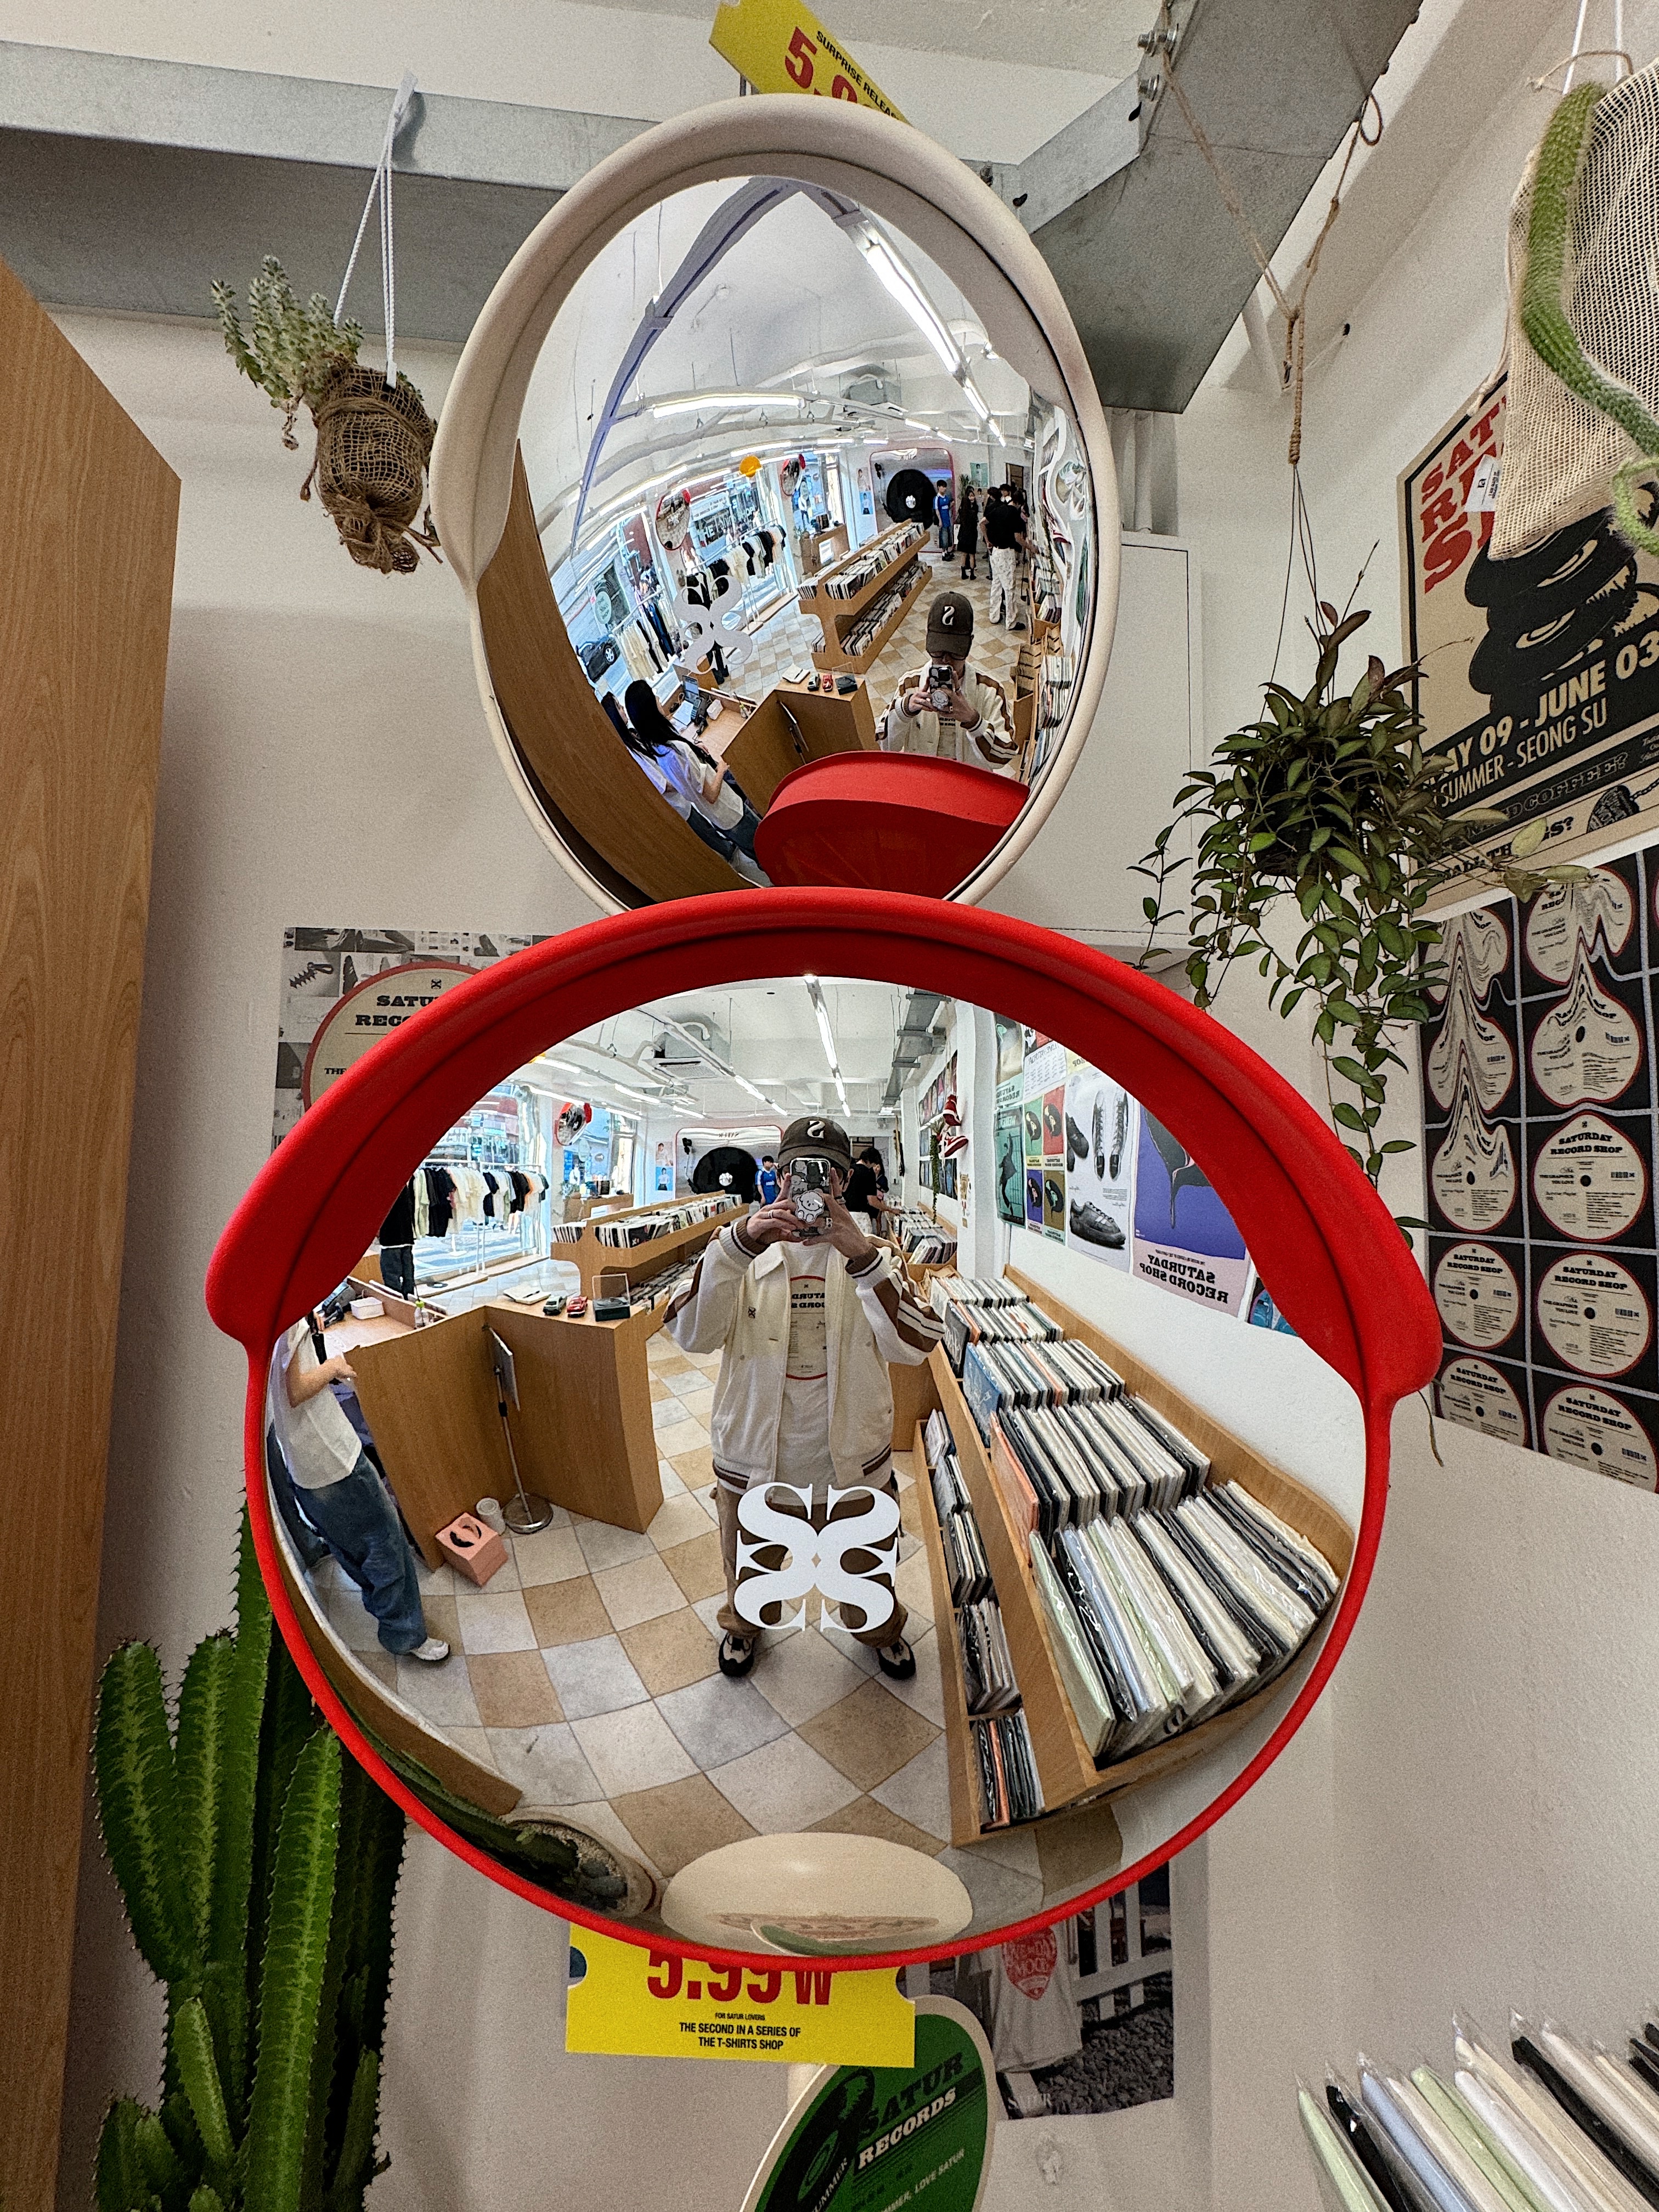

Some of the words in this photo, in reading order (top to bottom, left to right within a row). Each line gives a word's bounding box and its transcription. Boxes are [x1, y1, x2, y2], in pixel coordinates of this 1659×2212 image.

[817, 31, 862, 86] SURPRISE
[864, 83, 899, 120] RELEA
[1421, 395, 1506, 504] SAT
[1481, 715, 1513, 755] 09
[1520, 719, 1531, 729] -
[1535, 660, 1606, 727] JUNE
[1616, 630, 1659, 680] 03
[1441, 754, 1505, 808] SUMMER
[1517, 715, 1577, 768] SEONG
[1583, 698, 1607, 735] SU
[1523, 752, 1628, 811] COFFEE?
[377, 996, 441, 1007] SATU
[1559, 1132, 1612, 1144] SATURDAY
[1551, 1146, 1592, 1155] RECORD
[1594, 1145, 1622, 1154] SHOP
[1447, 1262, 1479, 1271] RECORD
[1454, 1254, 1495, 1263] SATURDAY
[1563, 1267, 1618, 1278] SATURDAY
[1555, 1276, 1596, 1286] RECORD
[1598, 1281, 1628, 1290] SHOP
[1456, 1367, 1498, 1383] SATURDAY
[1451, 1375, 1482, 1387] RECORD
[1483, 1384, 1506, 1394] SHOP
[1566, 1397, 1621, 1417] SATURDAY
[1558, 1404, 1600, 1421] RECORD
[1602, 1417, 1632, 1430] SHOP
[679, 2022, 696, 2033] THE
[698, 2023, 733, 2034] SECOND
[736, 2024, 746, 2035] IN
[747, 2025, 754, 2035] A
[757, 2026, 787, 2036] SERIES
[789, 2028, 801, 2038] OF
[698, 2036, 715, 2047] THE
[718, 2038, 757, 2049] T-SHIRTS
[759, 2039, 783, 2050] SHOP
[858, 2086, 956, 2169] RECORDS
[812, 2157, 847, 2212] UMMER
